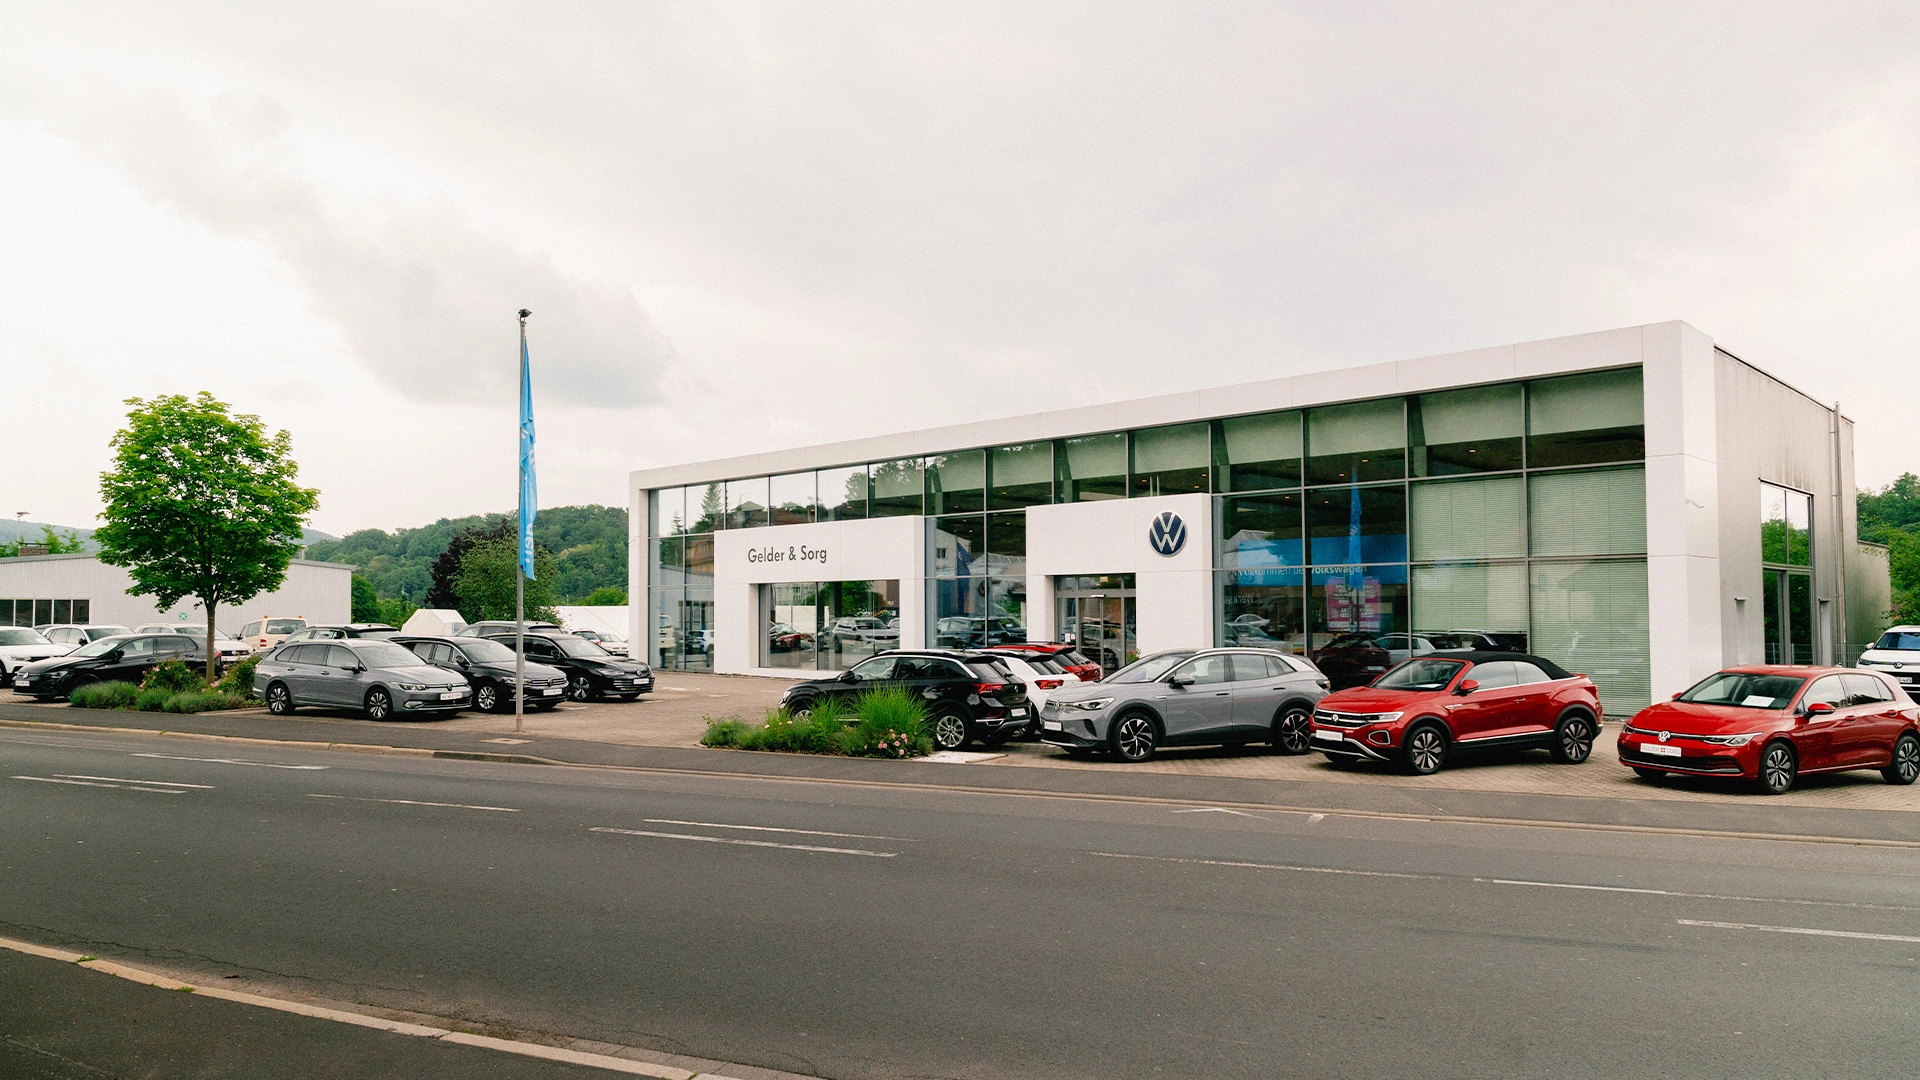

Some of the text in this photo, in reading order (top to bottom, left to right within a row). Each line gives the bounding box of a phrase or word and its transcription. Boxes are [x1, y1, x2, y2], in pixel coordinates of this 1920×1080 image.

[748, 545, 827, 564] Gelder & Sorg
[1293, 567, 1305, 575] be
